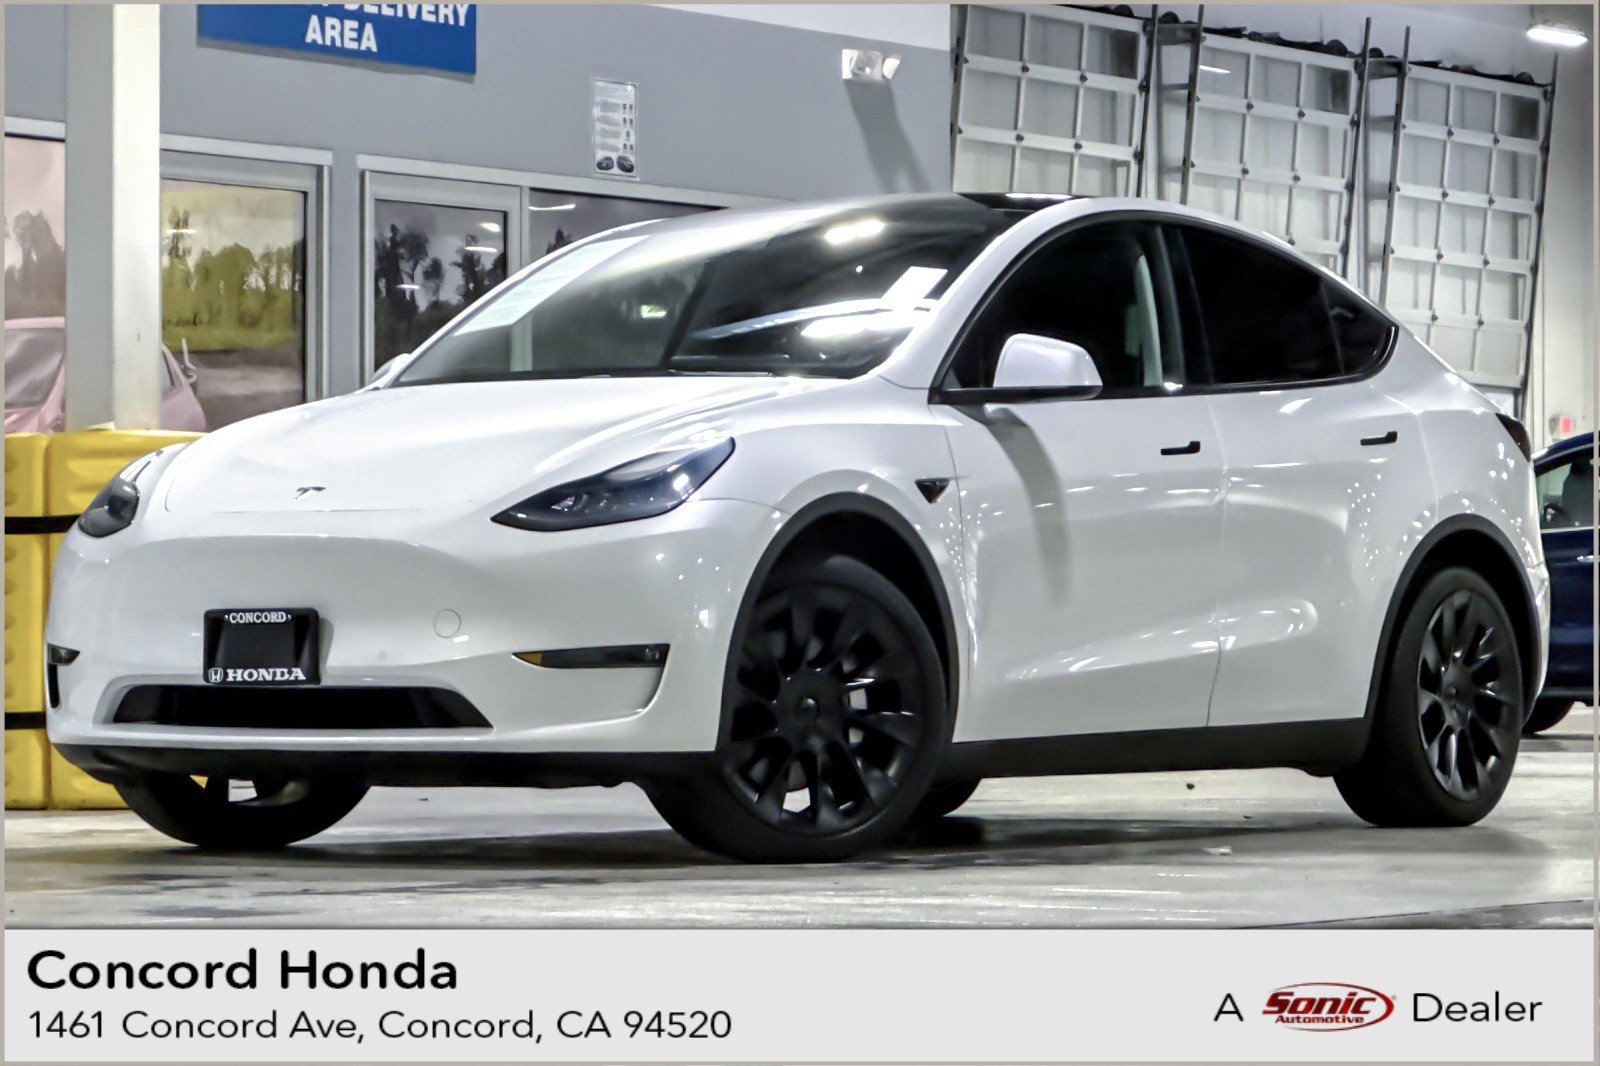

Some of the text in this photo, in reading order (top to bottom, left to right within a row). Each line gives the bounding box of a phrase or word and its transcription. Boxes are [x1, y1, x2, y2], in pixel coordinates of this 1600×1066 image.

[343, 4, 469, 27] VERY
[305, 14, 378, 53] AREA
[229, 611, 287, 624] CONCORD
[226, 667, 306, 681] HONDA
